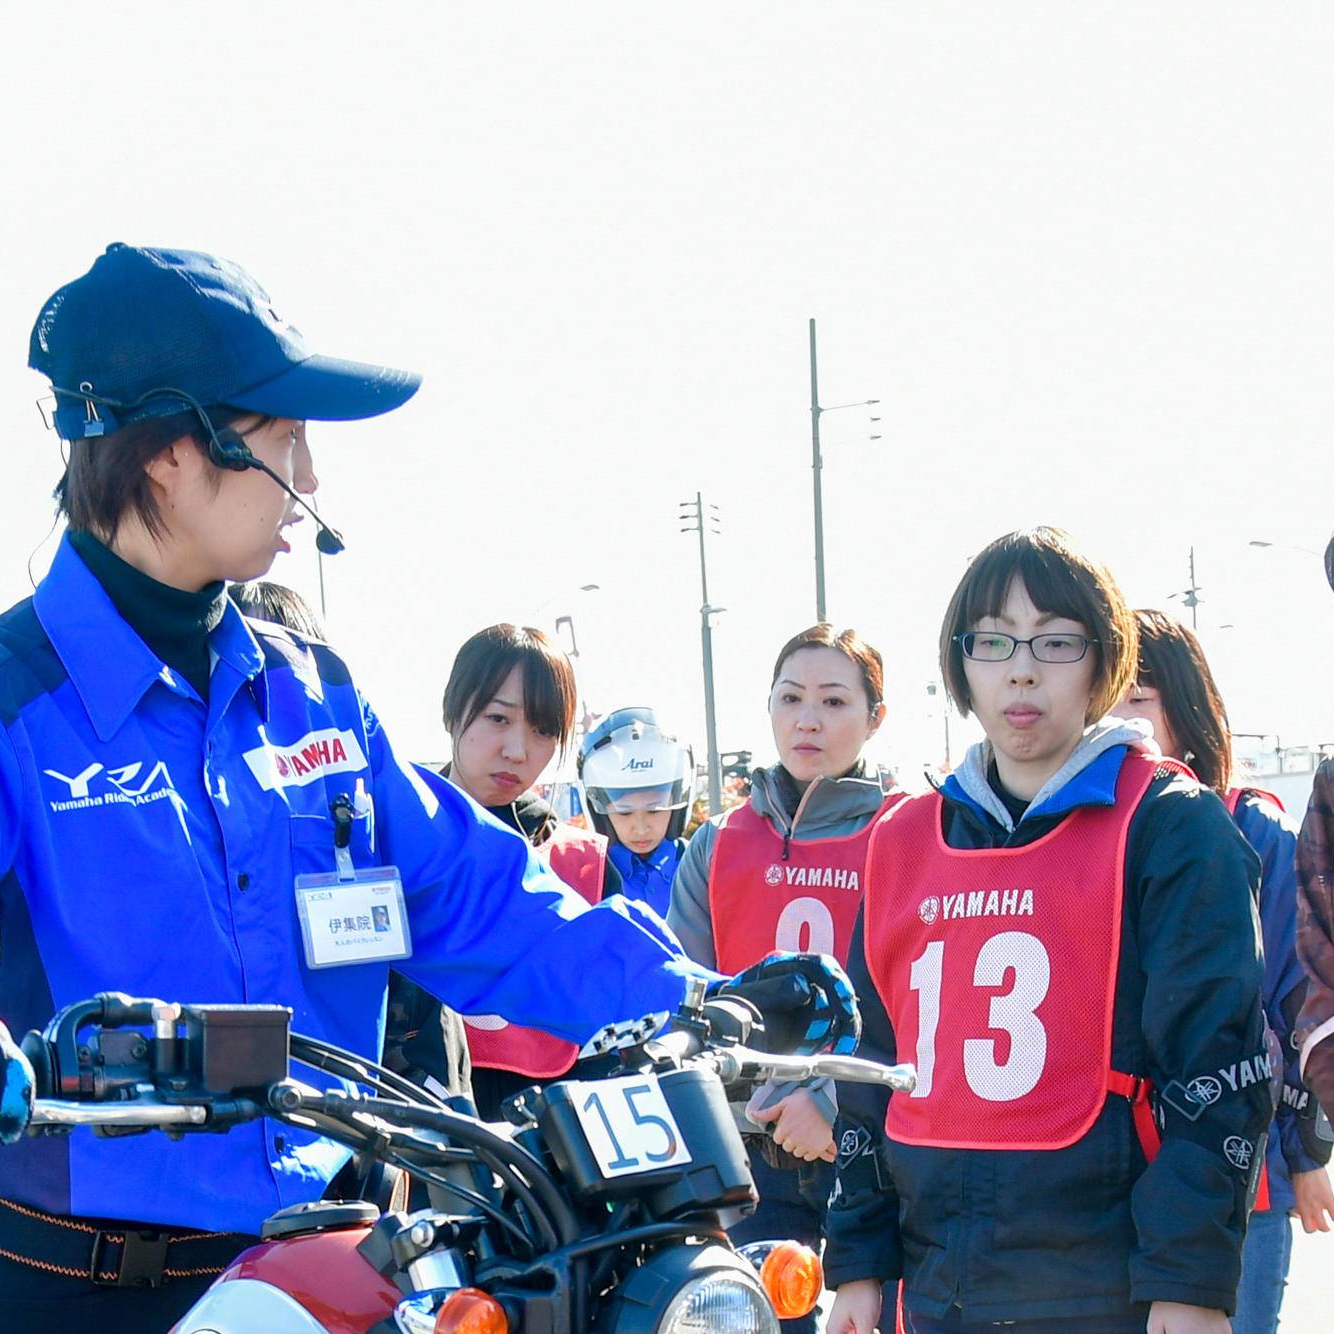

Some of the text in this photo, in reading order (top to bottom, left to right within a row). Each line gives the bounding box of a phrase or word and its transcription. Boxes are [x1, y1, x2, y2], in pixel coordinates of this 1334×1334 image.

[622, 758, 654, 771] Arai
[50, 796, 103, 812] Yamaha
[785, 866, 859, 890] YAMAHA
[941, 889, 1034, 920] YAMAHA
[910, 931, 1051, 1102] 13
[583, 1084, 677, 1170] 15
